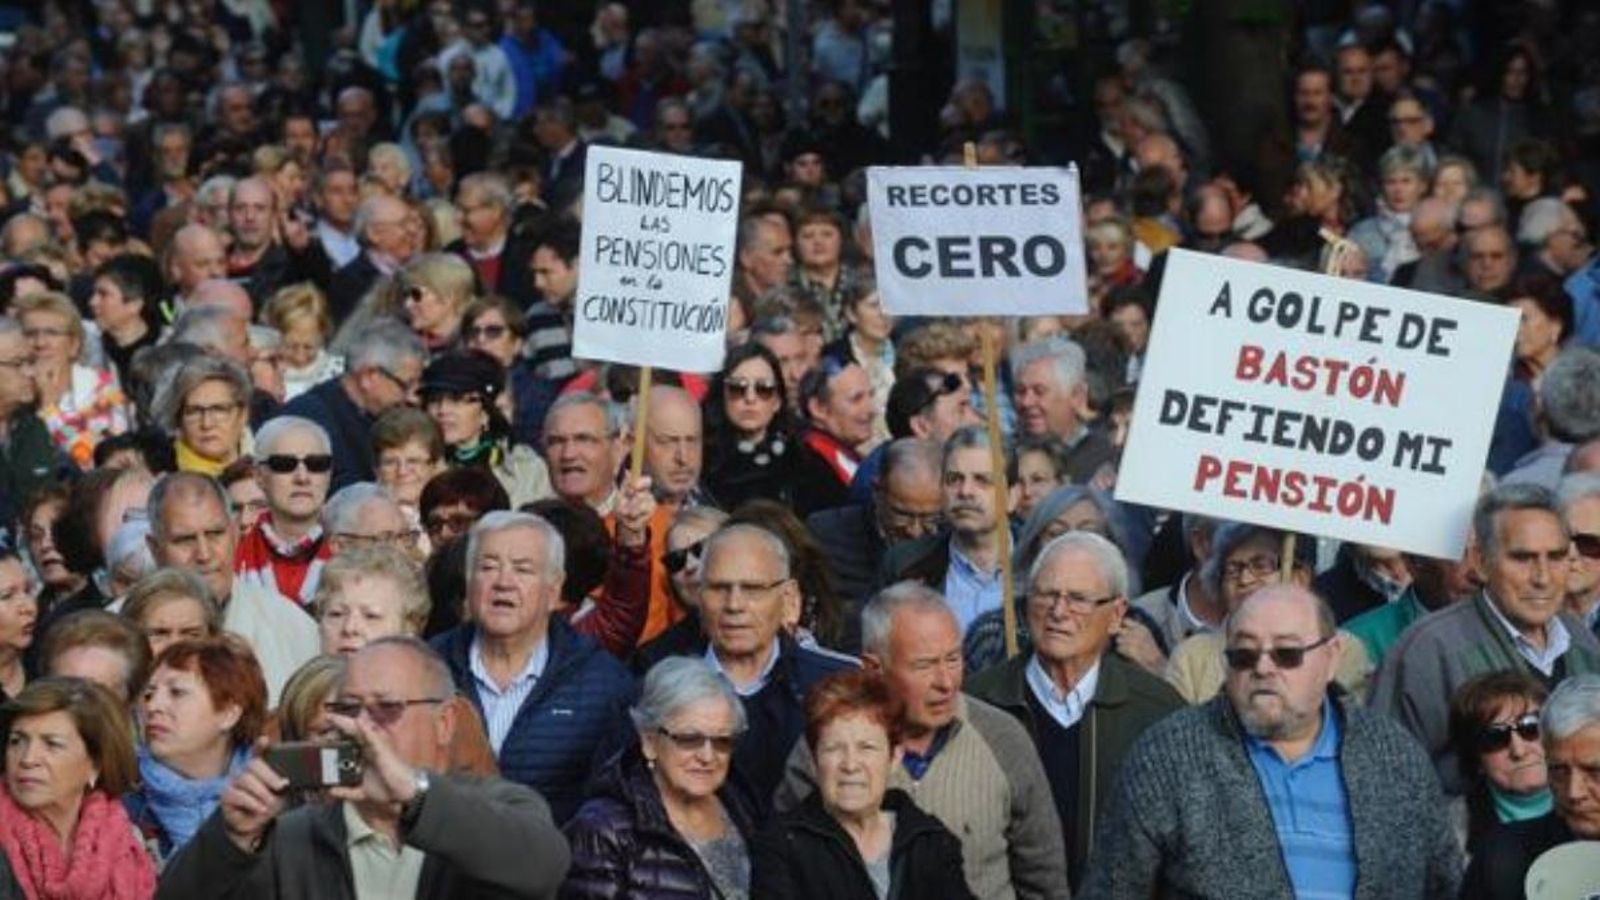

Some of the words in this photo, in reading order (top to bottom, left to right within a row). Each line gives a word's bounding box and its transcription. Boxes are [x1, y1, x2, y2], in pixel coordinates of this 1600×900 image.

[597, 162, 733, 213] BLINDEMOS
[887, 183, 1060, 207] RECORTES
[640, 215, 671, 232] LAS
[595, 235, 727, 277] PENSIONES
[893, 235, 1066, 279] CERO
[583, 296, 726, 333] CONSTITUCIÓN
[1209, 280, 1232, 318] A
[1247, 287, 1391, 344] GOLPE
[1396, 312, 1458, 356] DE
[1235, 345, 1406, 408] BASTÓN
[1158, 389, 1386, 461] DEFIENDO
[1393, 431, 1453, 475] MI
[1193, 455, 1396, 525] PENSIÓN
